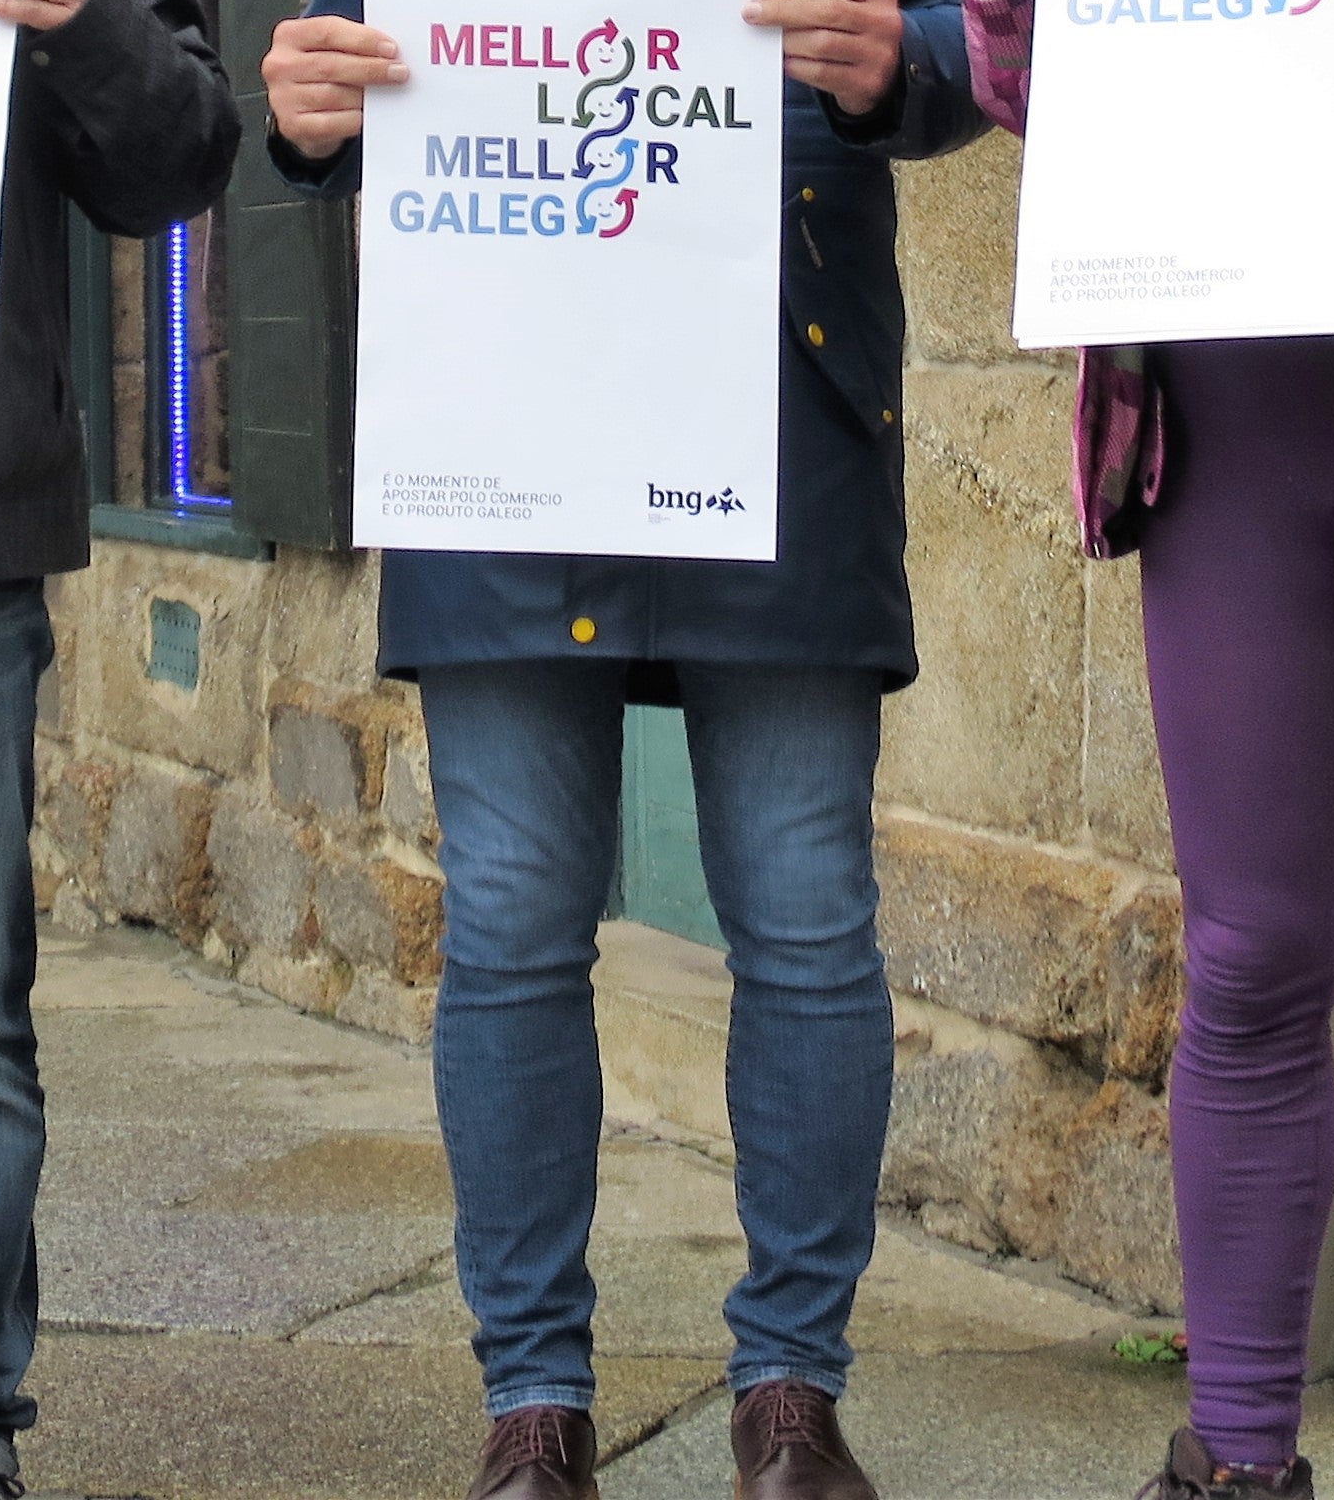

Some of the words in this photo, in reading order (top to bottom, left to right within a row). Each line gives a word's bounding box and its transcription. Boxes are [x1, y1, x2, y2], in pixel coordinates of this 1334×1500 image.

[430, 18, 681, 76] MELLOR
[537, 82, 752, 129] LOCAL
[425, 135, 680, 184] MELLOR
[389, 188, 639, 239] GALEGO
[1063, 259, 1073, 272] O
[1078, 256, 1155, 271] MOMENTO
[1159, 255, 1178, 269] DE
[1050, 273, 1118, 287] APOSTAR
[1122, 271, 1162, 285] POLO
[1166, 267, 1245, 284] COMERCIO
[1062, 289, 1072, 302] O
[1077, 286, 1148, 301] PRODUTO
[1152, 284, 1212, 299] GALEGO
[394, 473, 404, 486] O
[408, 474, 480, 488] MOMENTO
[483, 476, 501, 489] DE
[382, 489, 446, 502] APOSTAR
[450, 491, 486, 504] POLO
[490, 492, 562, 506] COMERCIO
[647, 482, 701, 516] bng
[393, 504, 403, 516] O
[407, 504, 474, 518] PRODUTO
[477, 506, 532, 520] GALEGO
